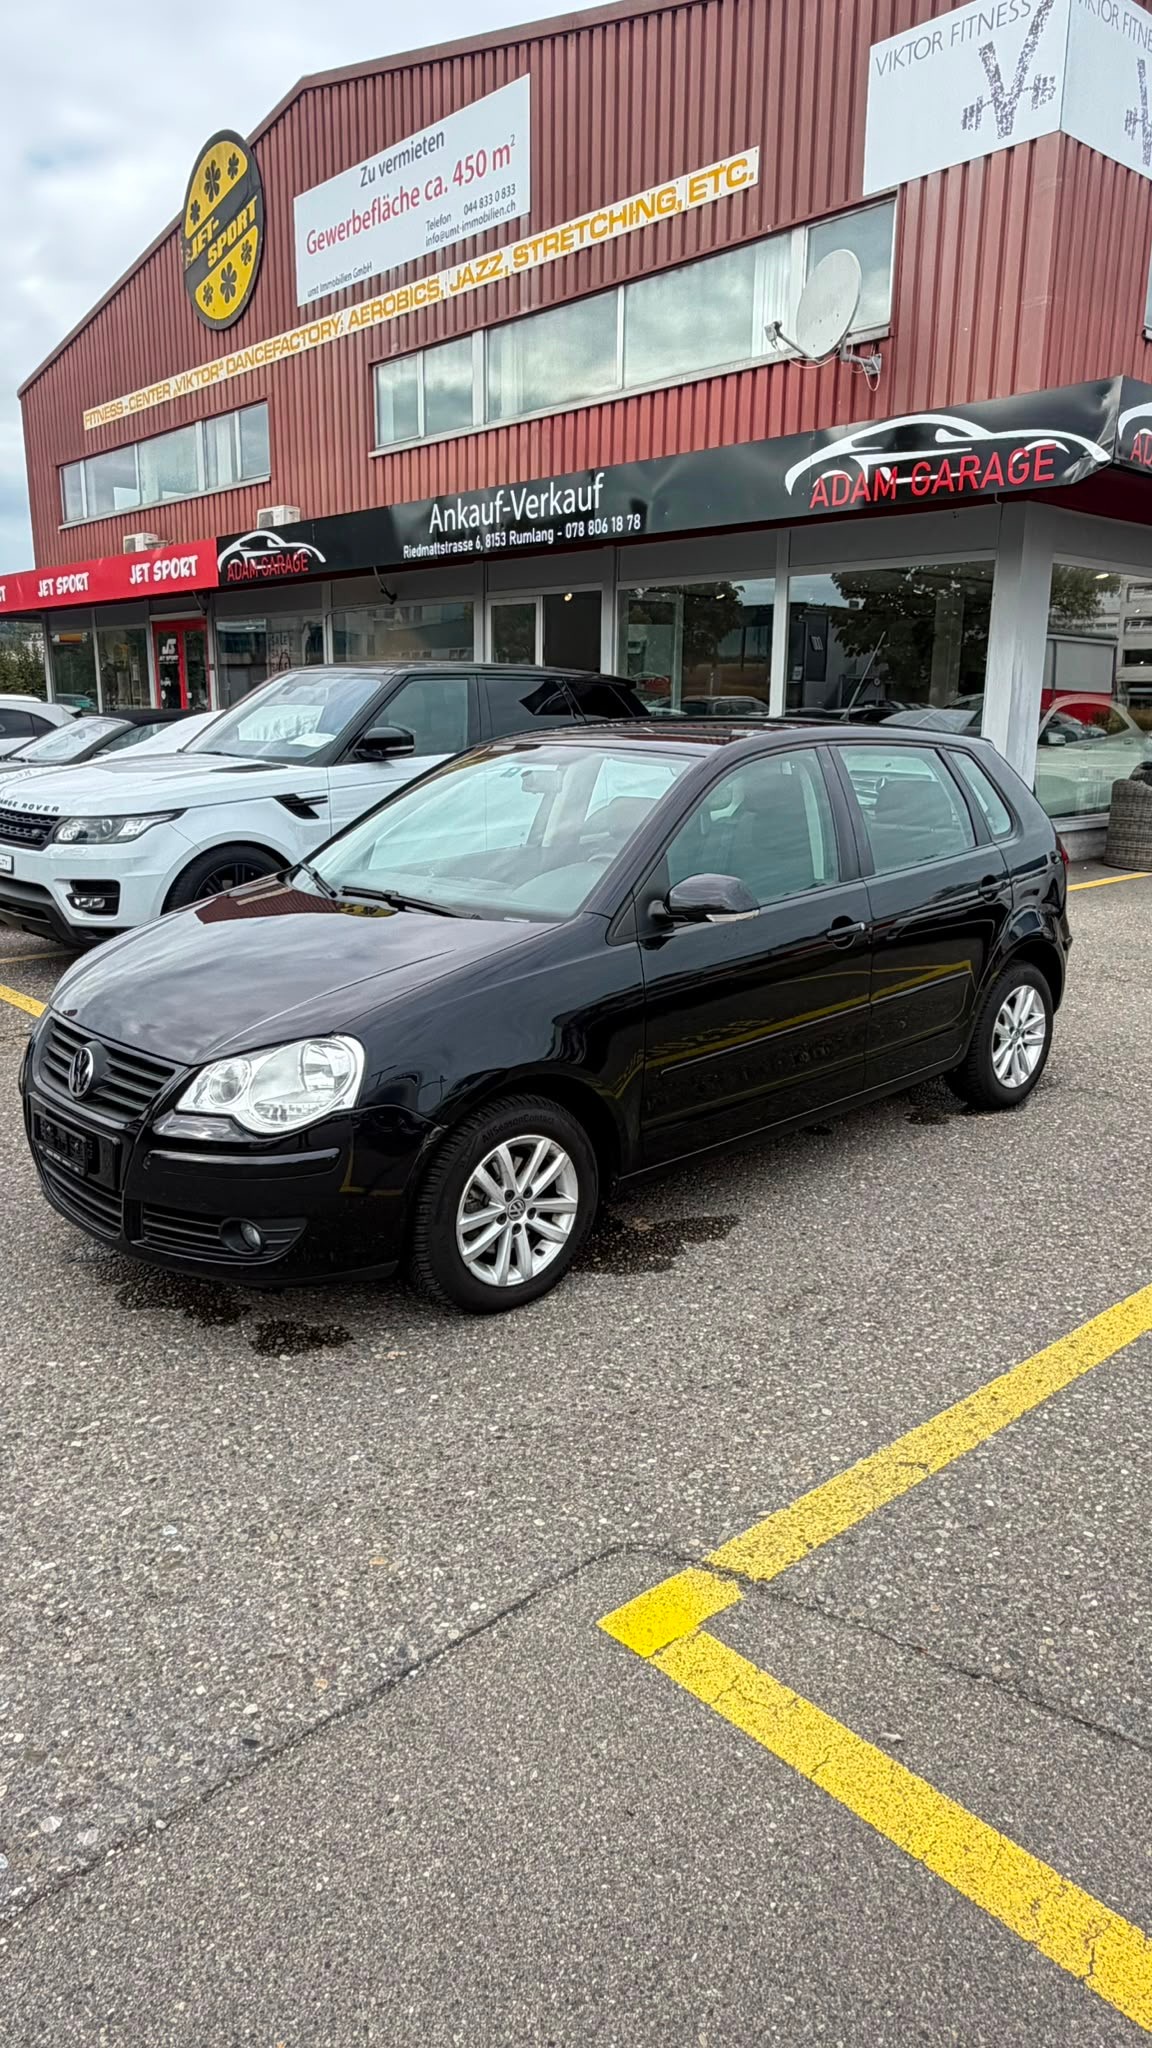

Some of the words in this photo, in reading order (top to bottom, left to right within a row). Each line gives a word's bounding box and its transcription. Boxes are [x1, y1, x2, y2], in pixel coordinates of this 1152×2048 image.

[875, 31, 943, 77] VIKTOR
[950, 0, 1031, 46] FITNESS
[1078, 0, 1119, 31] KTOR
[1122, 11, 1152, 54] FITNE
[360, 166, 376, 188] Zu
[378, 130, 445, 176] vermieten
[306, 185, 421, 255] Gewerbefläche
[424, 175, 448, 202] ca.
[452, 148, 488, 187] 450
[425, 212, 452, 232] Telefon
[463, 199, 478, 216] 044
[478, 193, 493, 209] 833
[494, 189, 500, 202] 0
[501, 182, 516, 200] 833
[207, 196, 258, 268] SPORT
[347, 278, 445, 332] AEROBICS,
[449, 250, 509, 292] JAZZ,
[512, 185, 683, 268] STRETCHING,
[688, 158, 755, 204] ETC.
[425, 199, 516, 248] info@umt-immobilien.ch
[352, 260, 373, 279] GmbH
[1129, 431, 1152, 466] AD
[808, 465, 899, 509] ADAM
[911, 442, 1058, 496] GARAGE
[428, 472, 606, 534] Ankauf-Verkauf
[403, 539, 474, 559] Riedmattstrasse
[475, 535, 483, 551] 6,
[485, 531, 507, 548] 8153
[509, 527, 554, 545] Rumlang
[565, 521, 585, 539] 078
[587, 517, 609, 536] 806
[611, 515, 624, 533] 18
[626, 513, 641, 531] 78
[37, 578, 54, 597] JET
[56, 571, 90, 595] SPORT
[129, 562, 151, 585] JET
[153, 554, 199, 582] SPORT
[227, 559, 259, 582] ADAM
[261, 551, 309, 577] GARAGE
[0, 798, 19, 808] ANGE
[21, 802, 60, 813] ROVER
